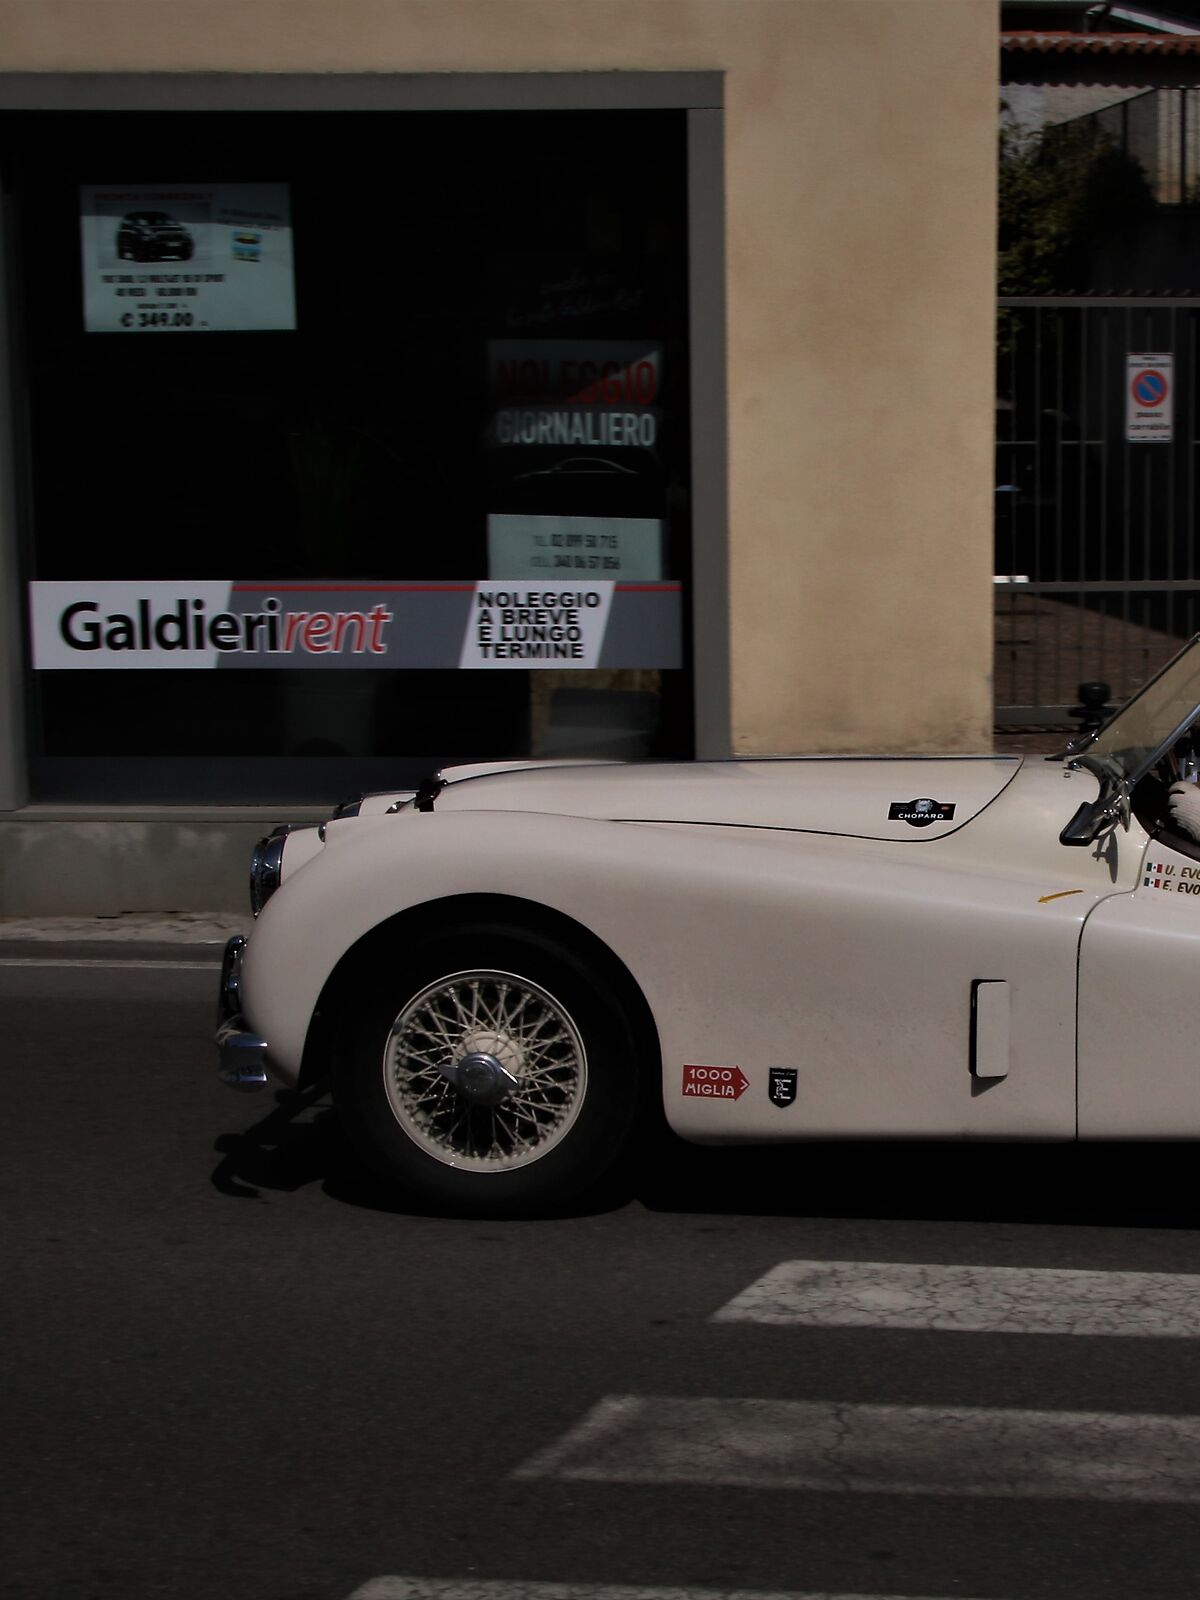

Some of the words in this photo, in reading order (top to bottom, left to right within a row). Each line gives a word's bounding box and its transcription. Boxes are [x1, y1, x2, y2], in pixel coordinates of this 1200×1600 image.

[496, 360, 657, 405] NOLEGGIO
[496, 411, 657, 447] GIORNALIERO
[478, 592, 600, 608] NOLEGGIO
[478, 609, 493, 625] A
[502, 609, 579, 625] BREVE
[480, 626, 492, 642] E
[502, 626, 581, 642] LUNGO
[478, 643, 584, 659] TERMINE
[1165, 864, 1176, 877] U.
[1162, 880, 1172, 892] E.
[689, 1068, 733, 1081] 1000
[685, 1083, 735, 1096] MIGLIA
